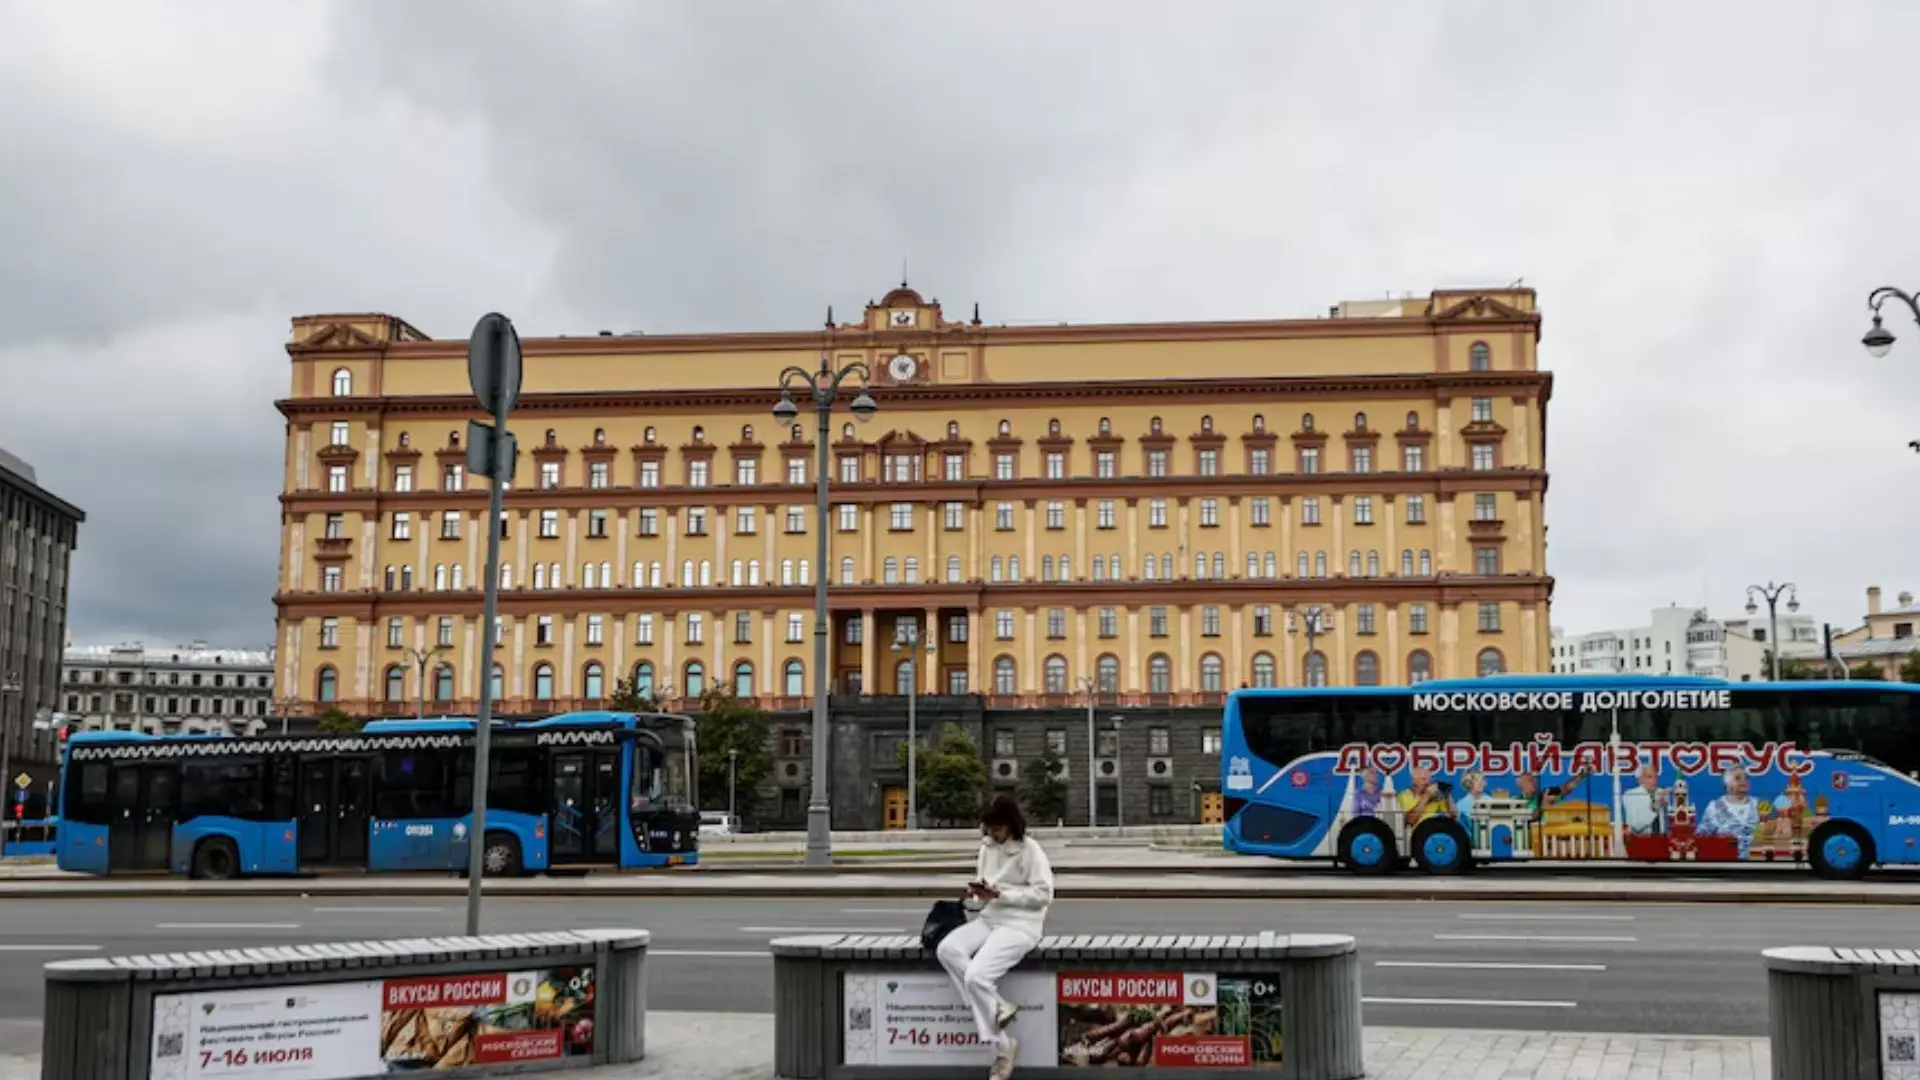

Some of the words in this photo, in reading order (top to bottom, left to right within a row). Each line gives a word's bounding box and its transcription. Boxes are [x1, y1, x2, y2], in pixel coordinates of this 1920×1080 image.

[1413, 692, 1573, 711] МОСКОВСКОЕ
[1580, 690, 1731, 712] ДОЛГОЛЕТИЕ
[389, 983, 441, 1005] ВКУСЫ
[443, 980, 501, 1001] РОССИИ
[1062, 978, 1112, 997] ВКУСЫ
[1118, 978, 1178, 997] РОССИИ
[1253, 981, 1277, 996] 0+
[936, 1031, 992, 1045] июл
[253, 1046, 313, 1065] июля
[1162, 1043, 1244, 1054] МОСКОВСКИЕ
[1194, 1053, 1245, 1064] СЕЗОНЫ
